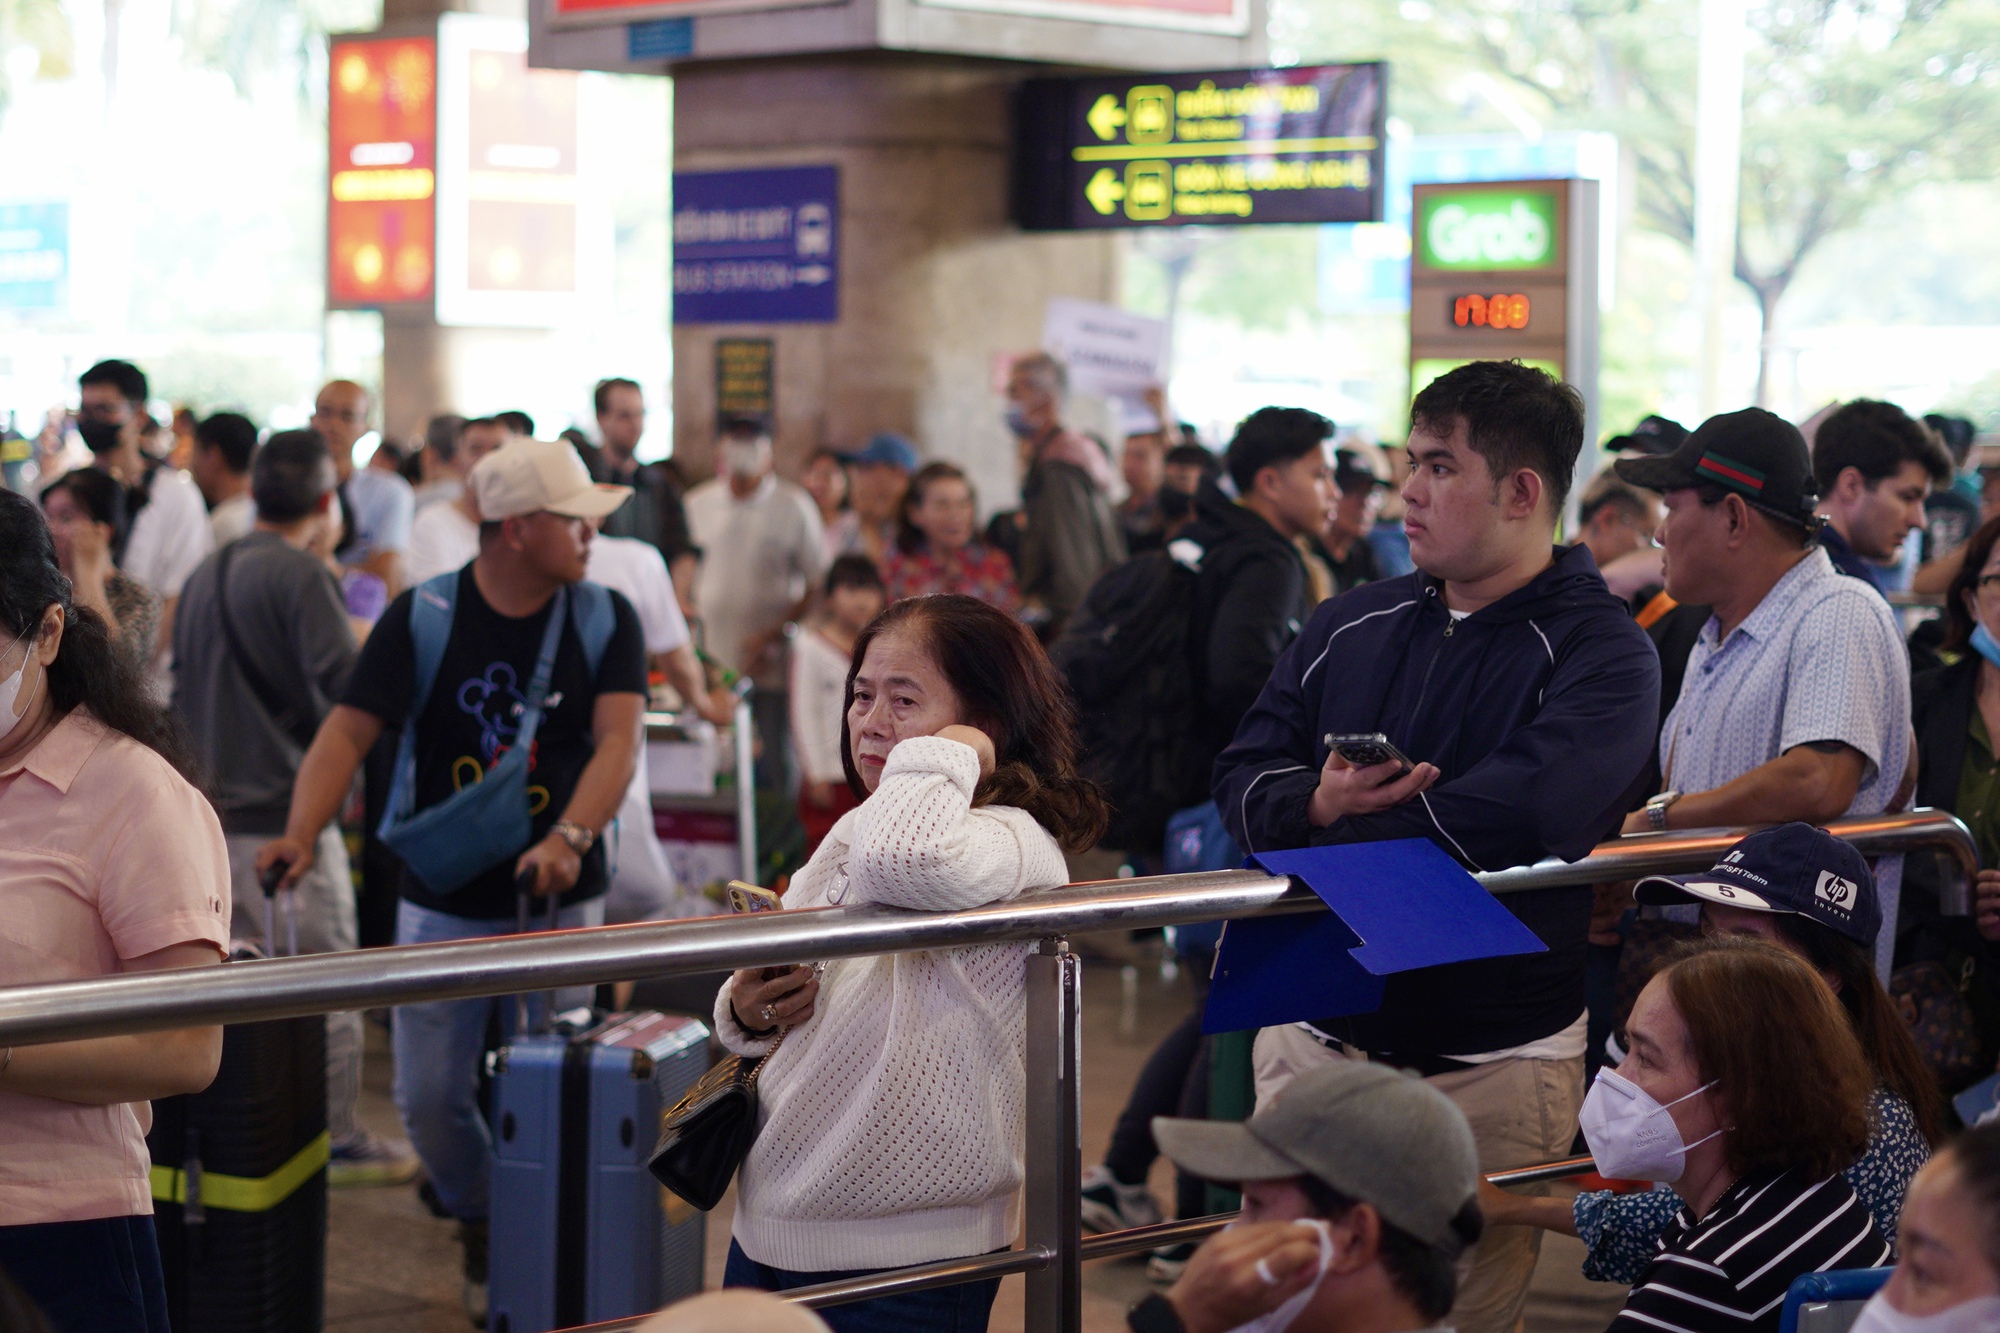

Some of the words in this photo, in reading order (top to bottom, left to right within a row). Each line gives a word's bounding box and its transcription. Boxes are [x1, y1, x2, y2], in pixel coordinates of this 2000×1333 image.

[1427, 199, 1549, 263] Grab
[1718, 885, 1736, 899] 5
[1827, 876, 1847, 903] hp
[1814, 898, 1851, 921] invent
[1636, 1127, 1659, 1139] KN95
